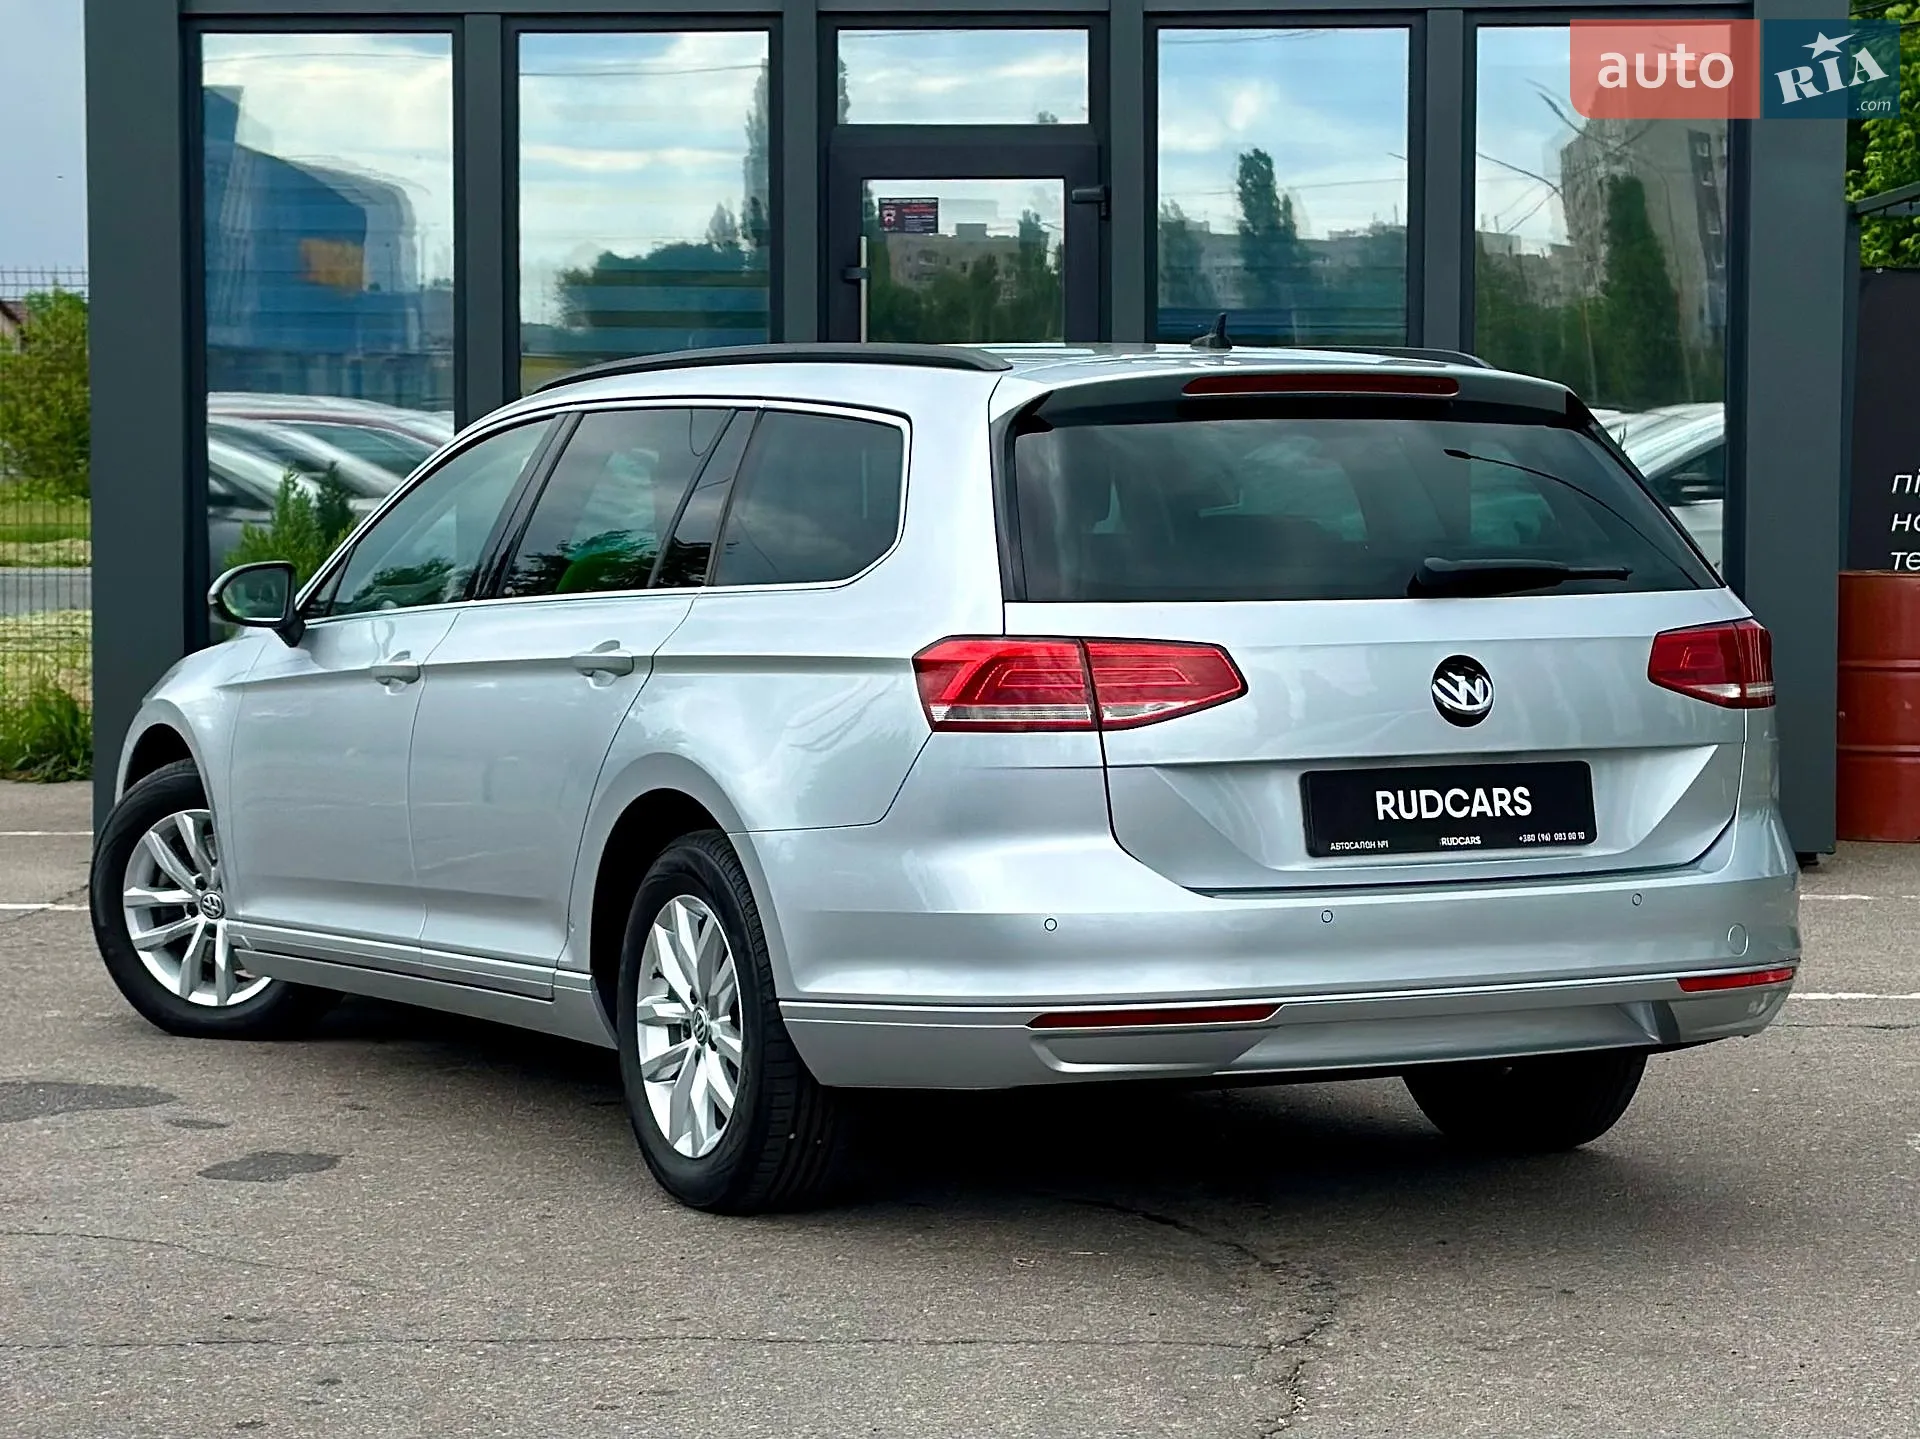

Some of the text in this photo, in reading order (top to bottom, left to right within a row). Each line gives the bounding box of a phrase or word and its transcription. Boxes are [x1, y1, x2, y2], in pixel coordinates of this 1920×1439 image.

[1891, 468, 1920, 495] пі
[1375, 786, 1532, 821] RUDCARS
[1440, 835, 1482, 846] RUDCARS
